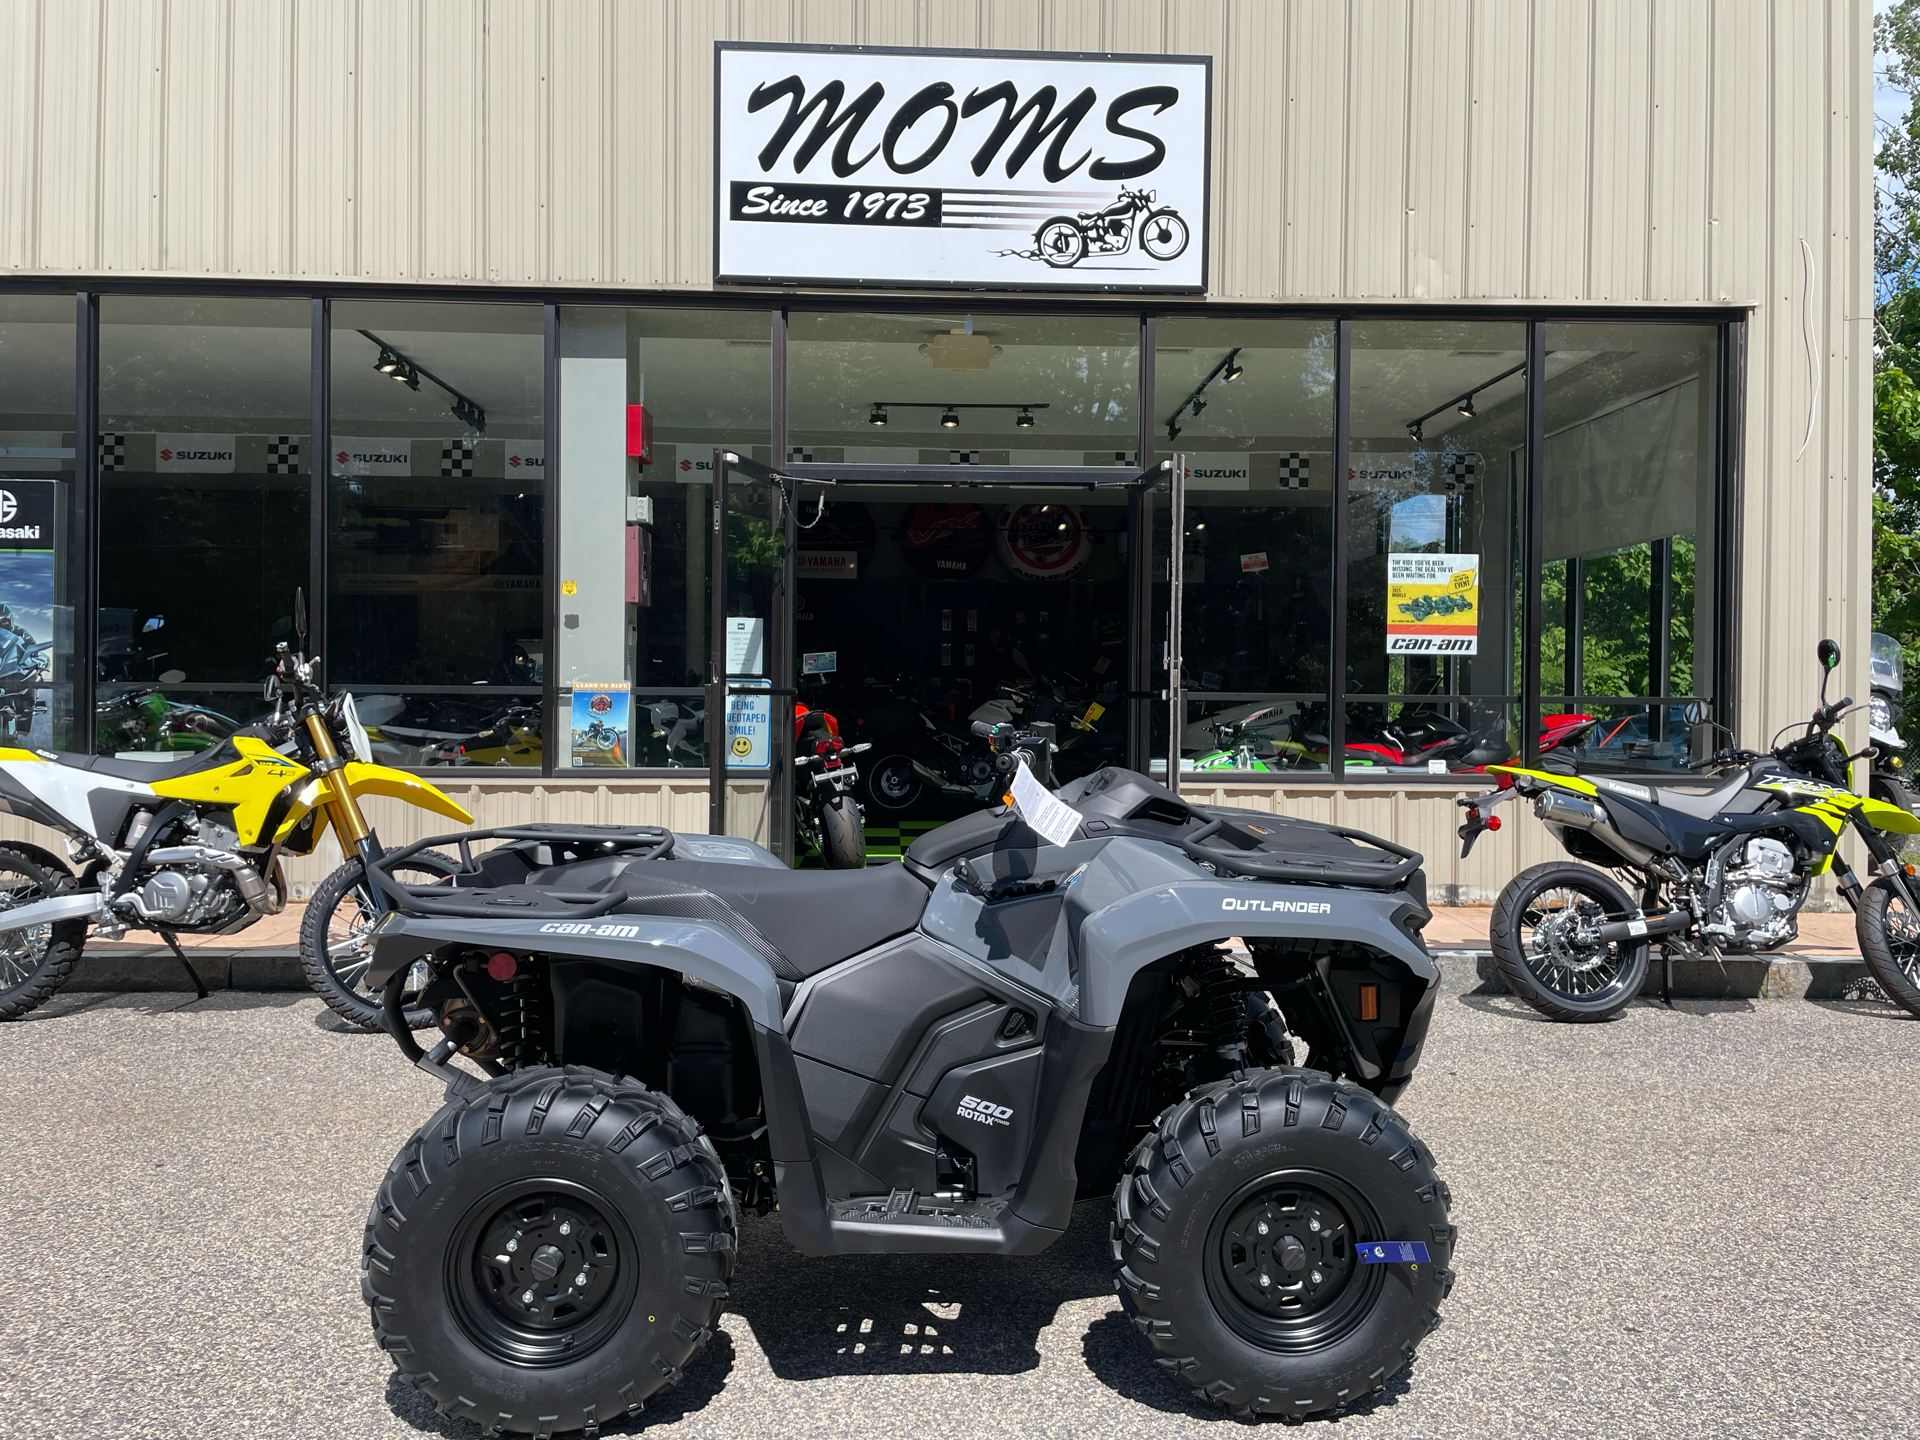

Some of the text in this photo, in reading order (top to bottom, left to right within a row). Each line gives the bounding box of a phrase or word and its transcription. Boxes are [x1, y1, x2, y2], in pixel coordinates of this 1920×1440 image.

[747, 74, 1179, 183] MOMS
[740, 186, 931, 220] Since 1973
[176, 451, 233, 460] SUZUKI
[352, 454, 408, 463] SUZUKI
[1193, 469, 1246, 478] SUZUKI
[1359, 470, 1412, 479] SUZUKI
[805, 506, 830, 517] YAMHA
[0, 525, 40, 539] asaki
[808, 556, 846, 567] YAMAHA
[936, 560, 967, 570] YAMAHA
[504, 579, 541, 589] YAMAHA
[1454, 580, 1470, 589] EVENT
[1391, 638, 1473, 651] can-am
[731, 701, 755, 710] BEING
[726, 713, 766, 723] DEOTAPED
[728, 725, 756, 735] SMILE!
[1609, 781, 1649, 799] Kawasaki
[1221, 897, 1331, 914] OUTLANDER
[539, 923, 640, 938] can-am
[960, 1095, 1014, 1119] 500
[956, 1106, 995, 1126] ROTAX
